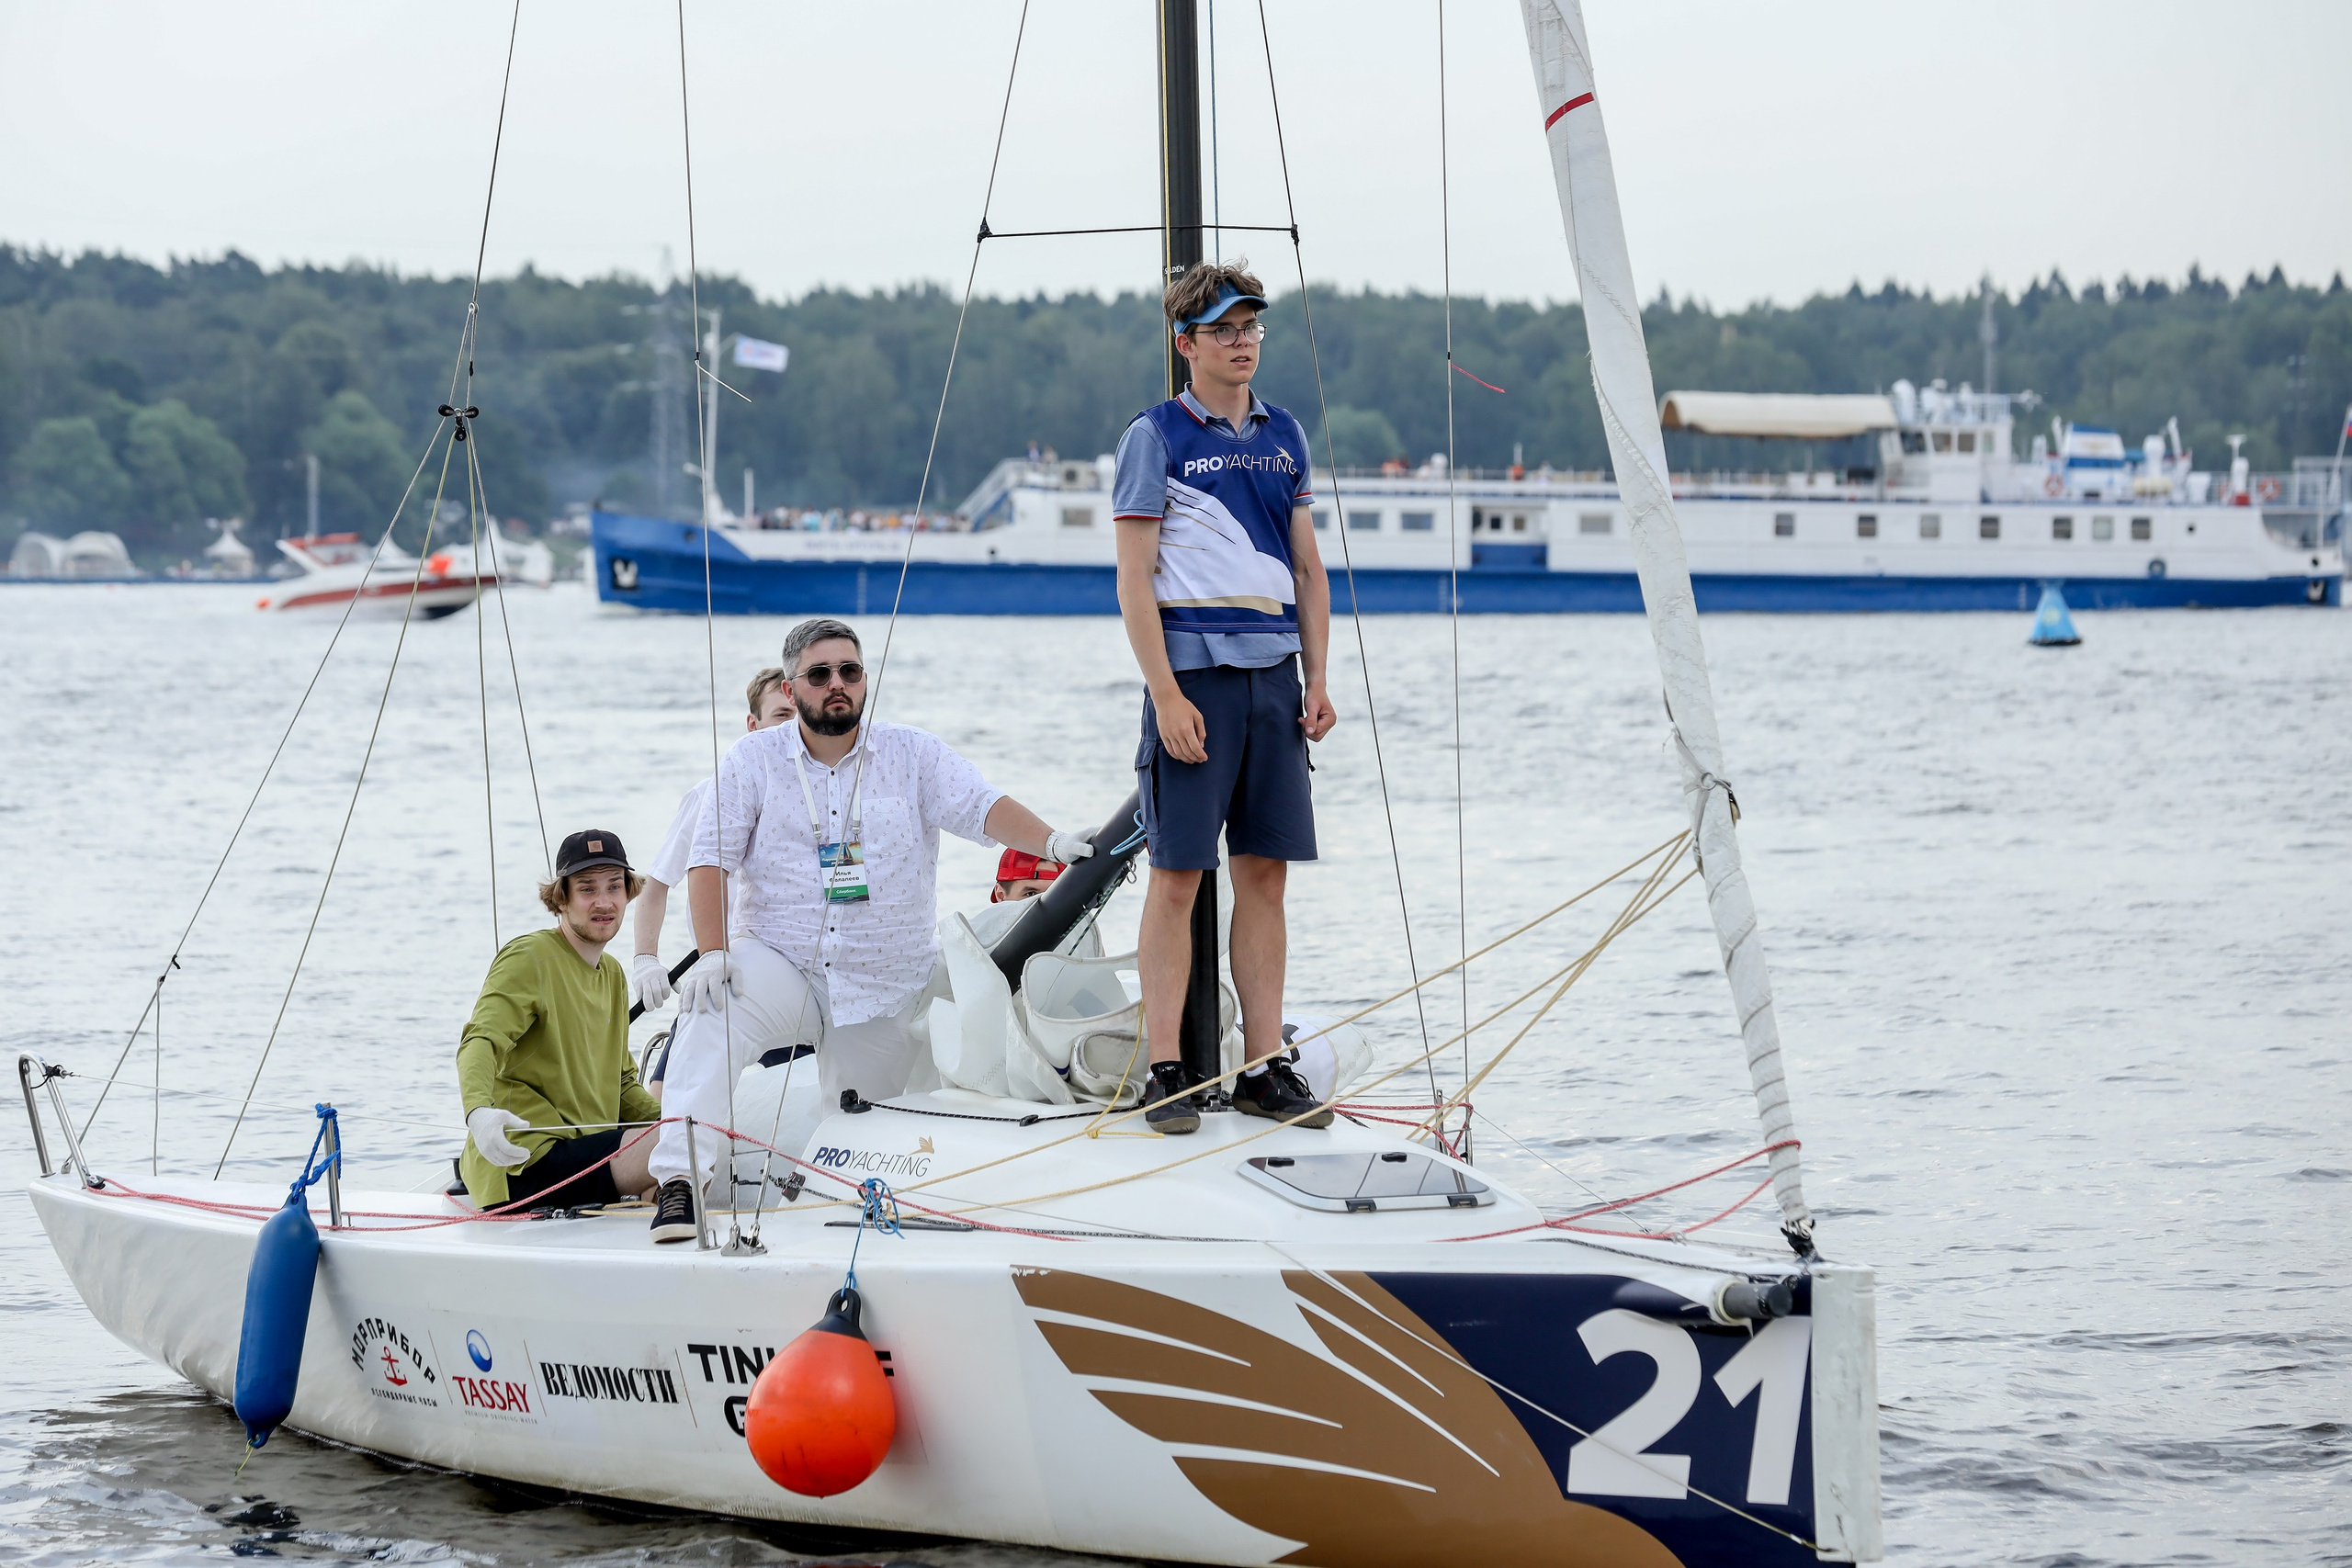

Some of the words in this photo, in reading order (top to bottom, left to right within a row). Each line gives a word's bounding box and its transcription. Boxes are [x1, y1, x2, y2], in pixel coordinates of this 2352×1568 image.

[1184, 453, 1297, 477] PROYACHTING
[812, 1146, 931, 1177] PROYACHTING
[352, 1317, 436, 1384] МОРПРИБОР
[452, 1375, 531, 1414] TASSAY
[539, 1361, 680, 1404] ВЕДОМОСТИ
[1566, 1308, 1813, 1506] 21
